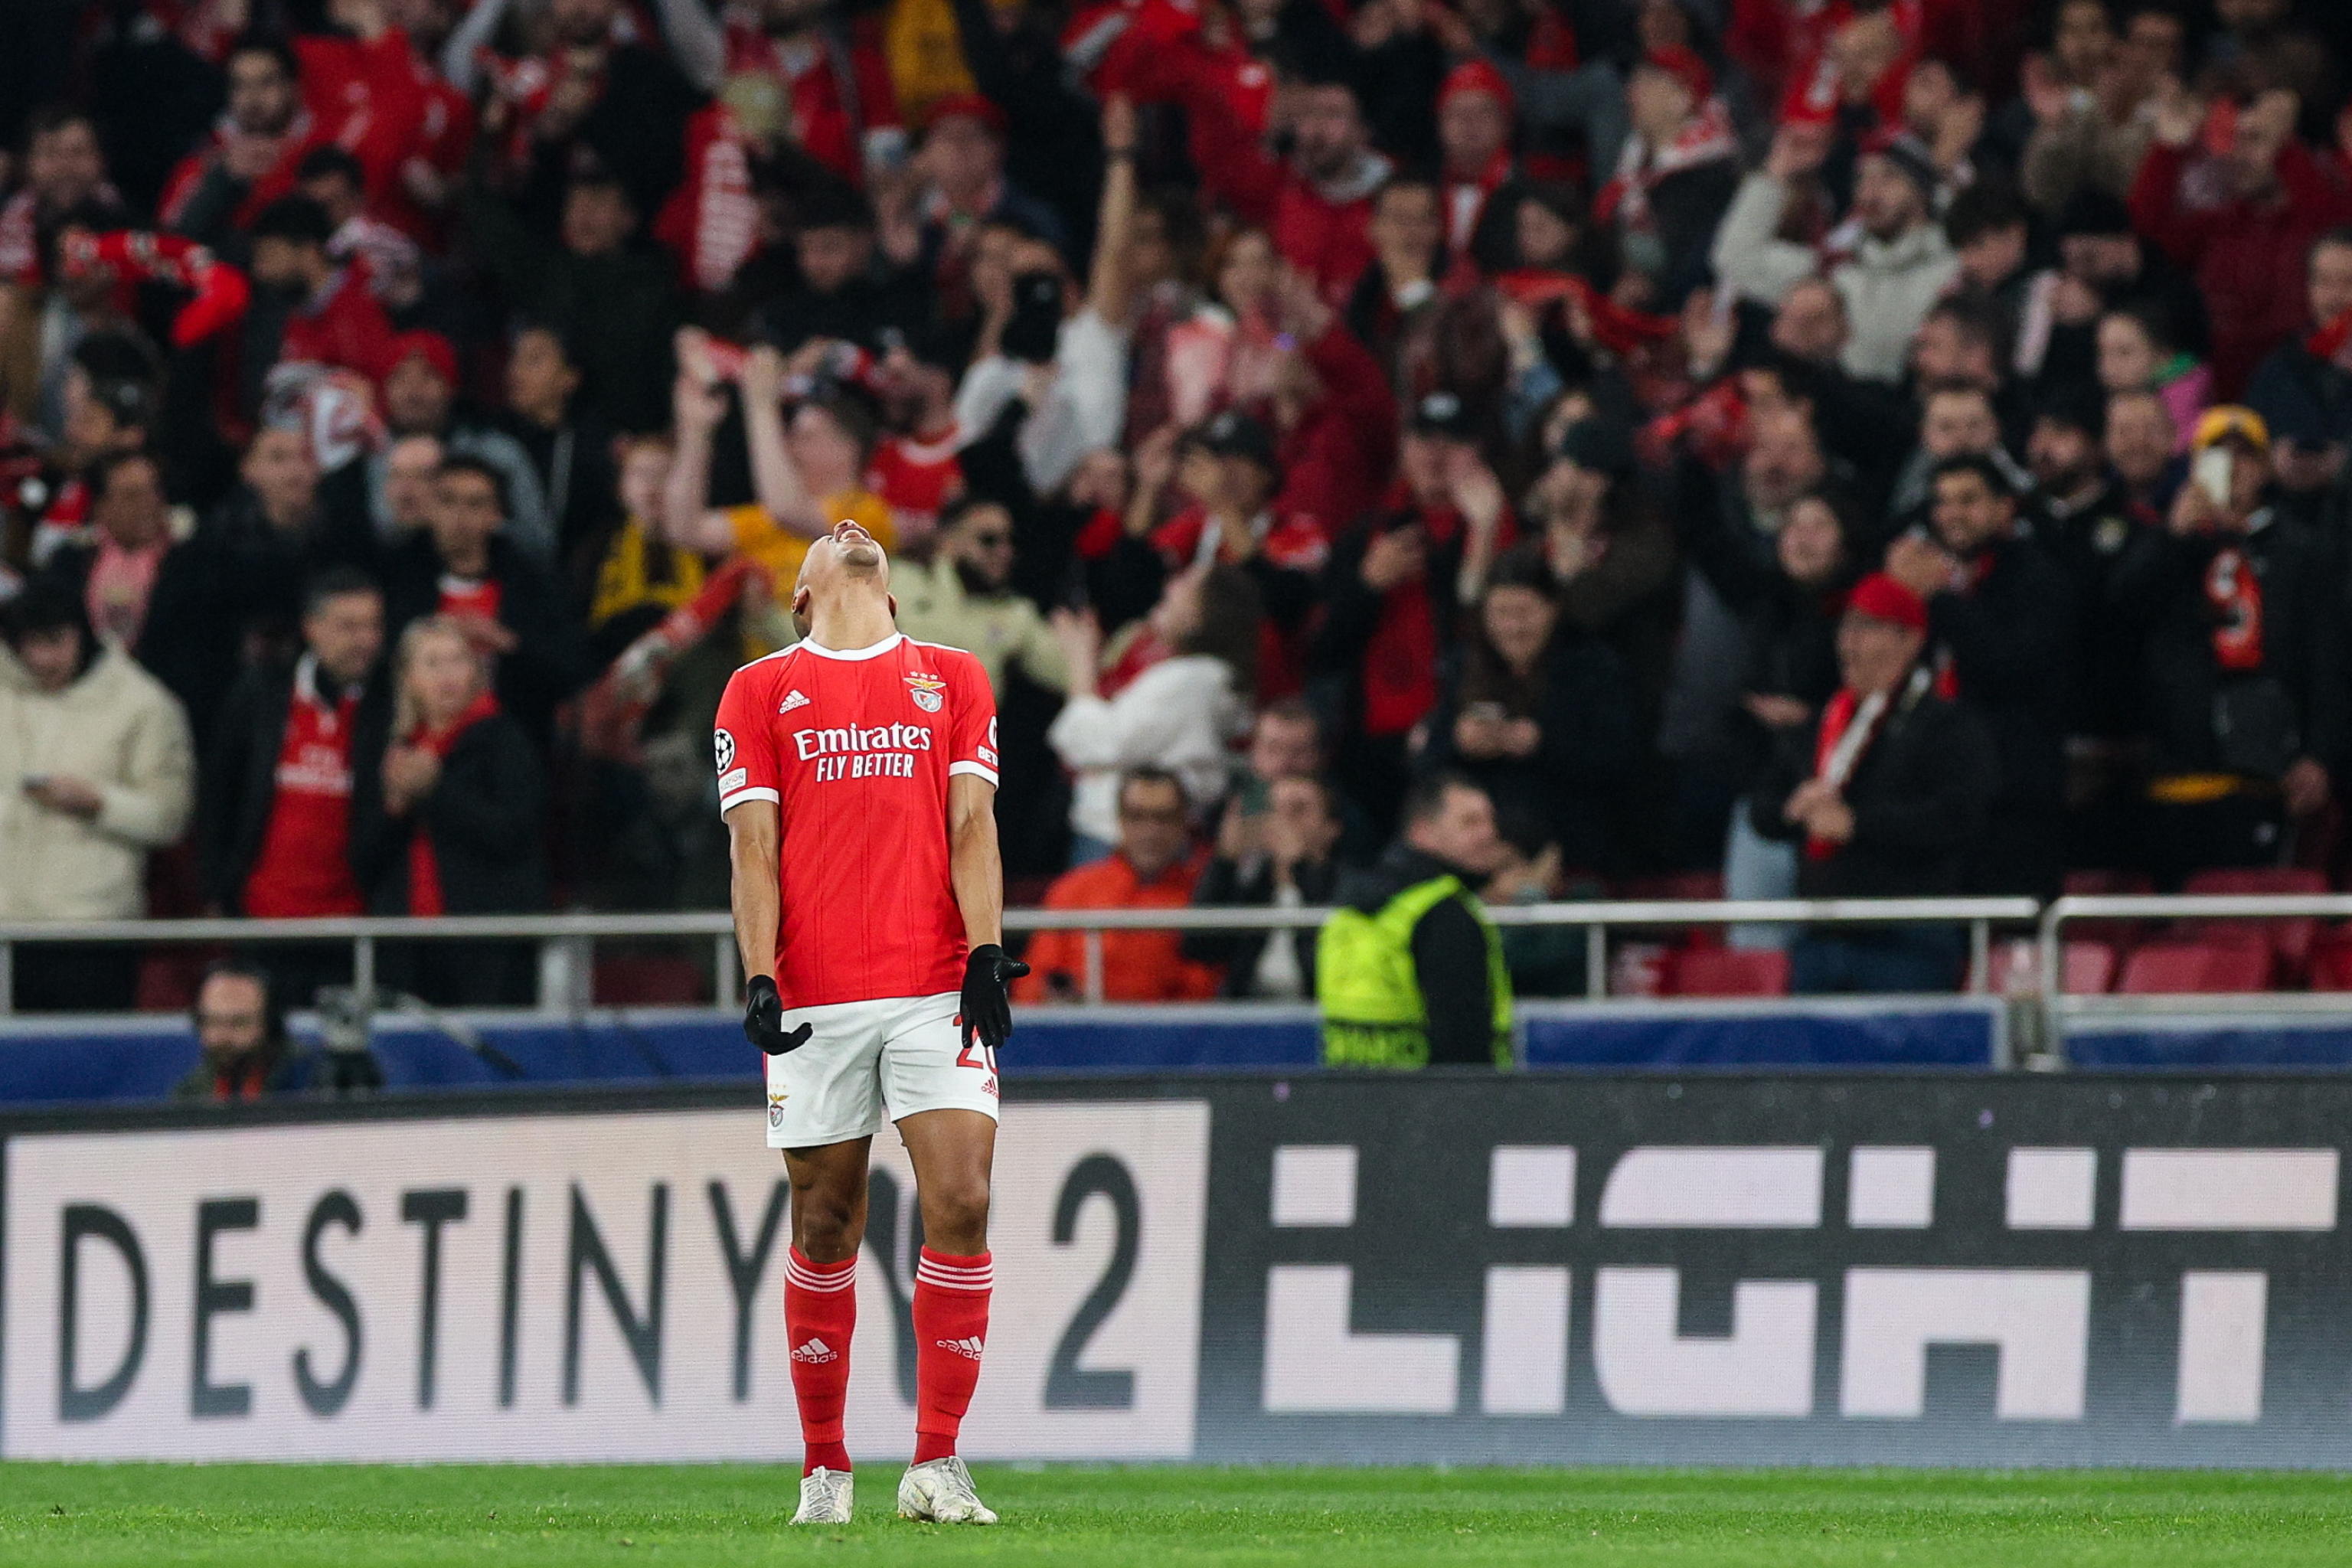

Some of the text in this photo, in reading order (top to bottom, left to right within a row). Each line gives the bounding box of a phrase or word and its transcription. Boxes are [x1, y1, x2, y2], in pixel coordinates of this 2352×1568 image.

[779, 697, 811, 714] adidas
[792, 720, 932, 761] Emirates
[816, 753, 914, 782] FLY BETTER
[976, 744, 998, 768] BET
[57, 1152, 1139, 1422] DESTINY 2
[1263, 1145, 2341, 1421] LIGHT
[790, 1350, 838, 1364] adidas
[936, 1340, 983, 1361] adida
